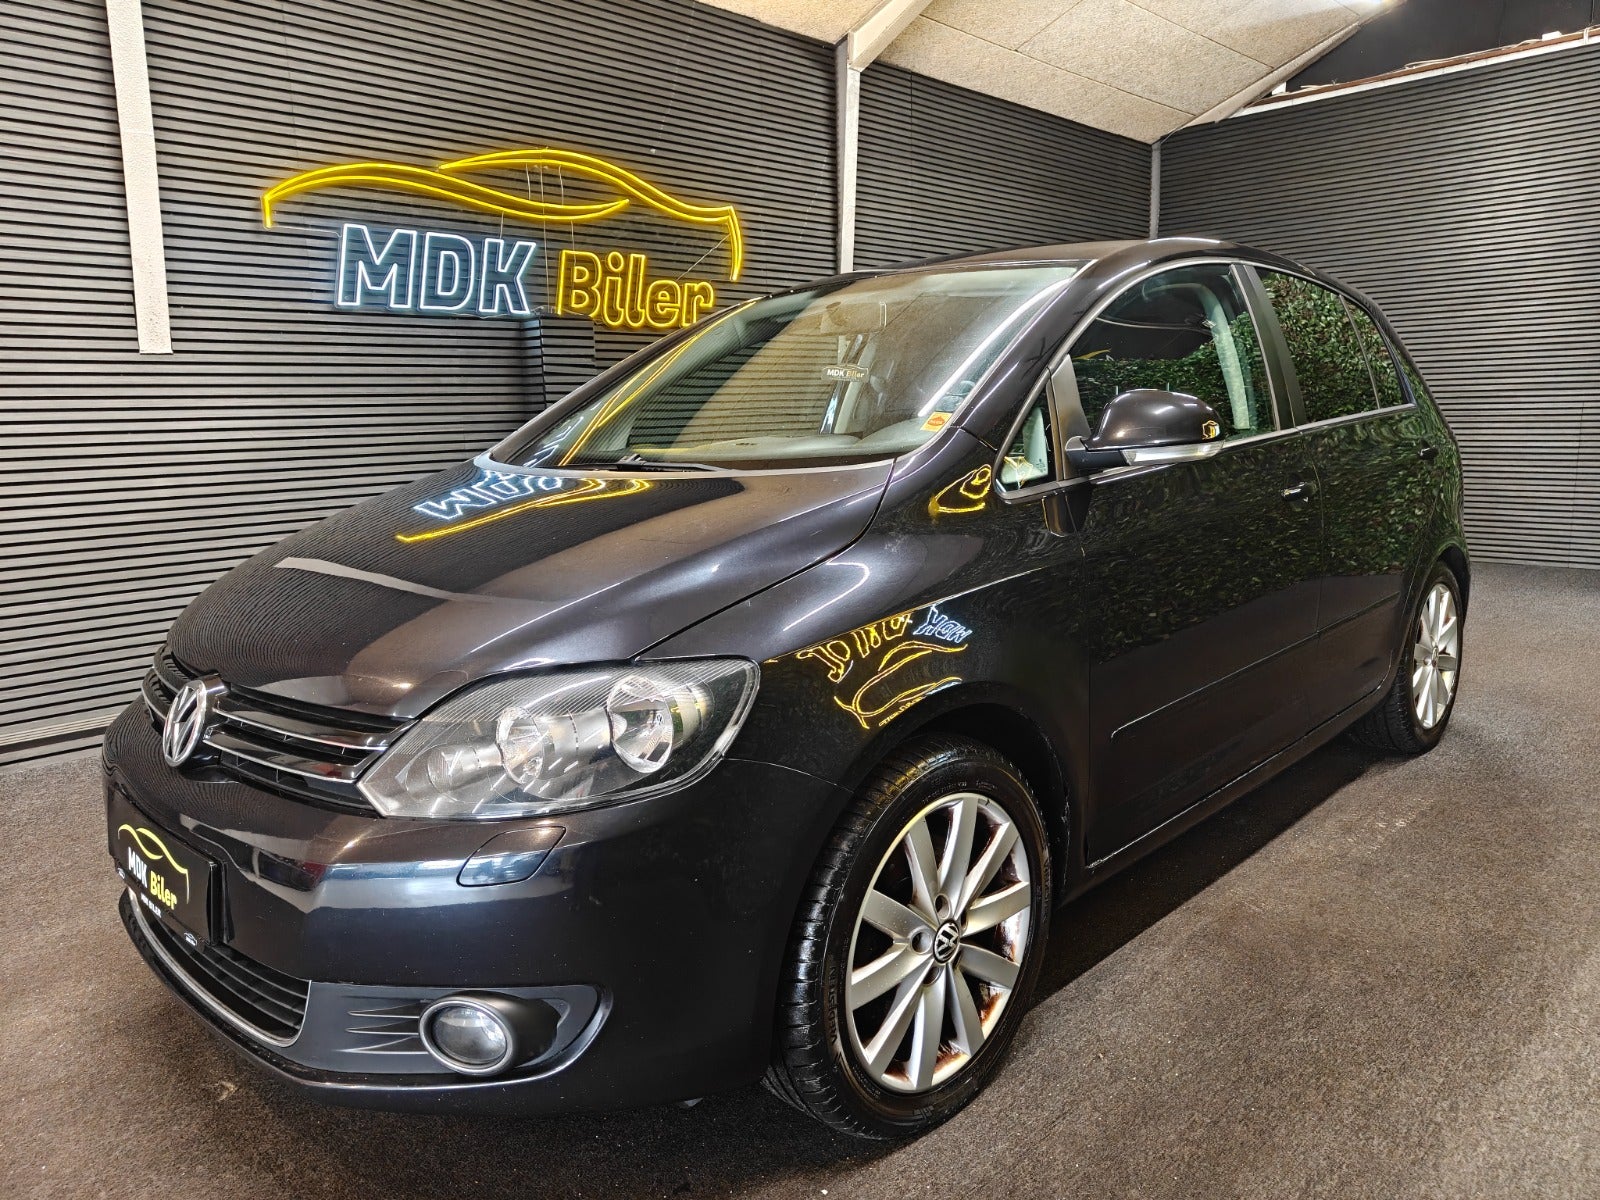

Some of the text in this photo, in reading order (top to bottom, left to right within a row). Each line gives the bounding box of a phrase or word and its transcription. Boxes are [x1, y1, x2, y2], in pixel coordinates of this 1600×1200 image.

[336, 223, 715, 328] MDK Biler
[826, 368, 845, 377] MDK
[128, 846, 148, 889] MDK
[150, 870, 178, 911] Biler
